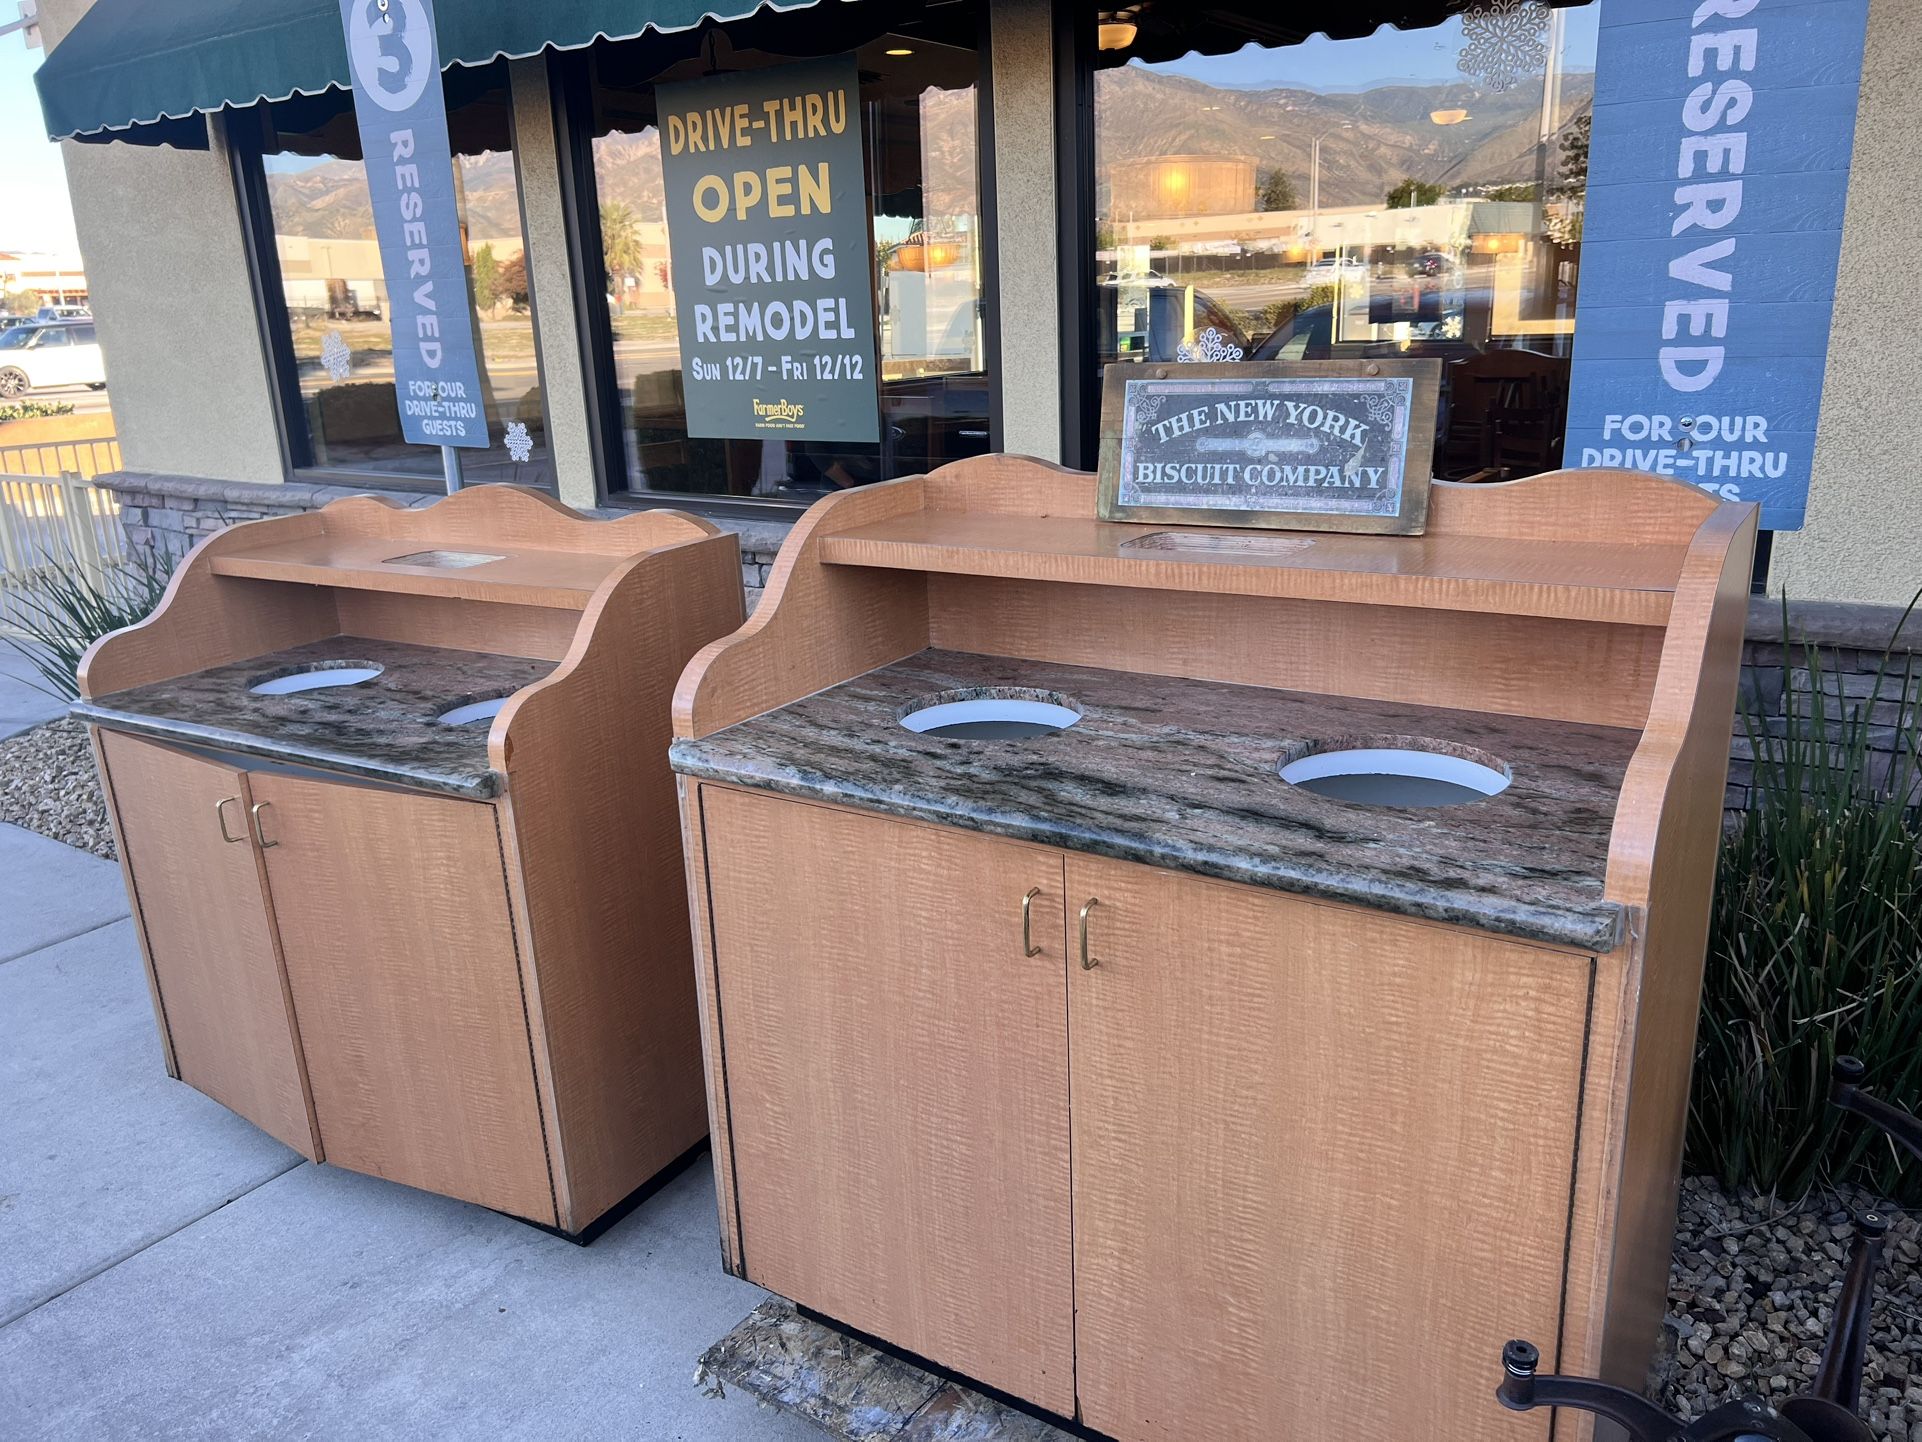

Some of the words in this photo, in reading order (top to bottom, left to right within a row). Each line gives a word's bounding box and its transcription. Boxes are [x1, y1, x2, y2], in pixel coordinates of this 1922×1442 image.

[365, 0, 413, 94] 3
[668, 89, 847, 156] DRIVE-THRU
[692, 162, 832, 223] OPEN
[389, 128, 443, 369] RESERVED
[702, 237, 836, 286] DURING
[694, 297, 856, 343] REMODEL
[726, 355, 763, 381] 12/7
[813, 354, 864, 380] 12/12
[408, 380, 434, 397] FOR
[438, 381, 467, 398] OUR
[405, 400, 477, 418] DRIVE-THRU
[422, 419, 466, 437] GUESTS
[1151, 407, 1211, 444] THE
[1215, 399, 1279, 425] NEW
[1283, 400, 1370, 447] YORK
[1602, 414, 1673, 441] FOR
[1688, 414, 1769, 443] OUR
[1135, 462, 1241, 485] BISCUIT
[1243, 464, 1386, 489] COMPANY
[1581, 447, 1788, 479] DRIVE-THRU
